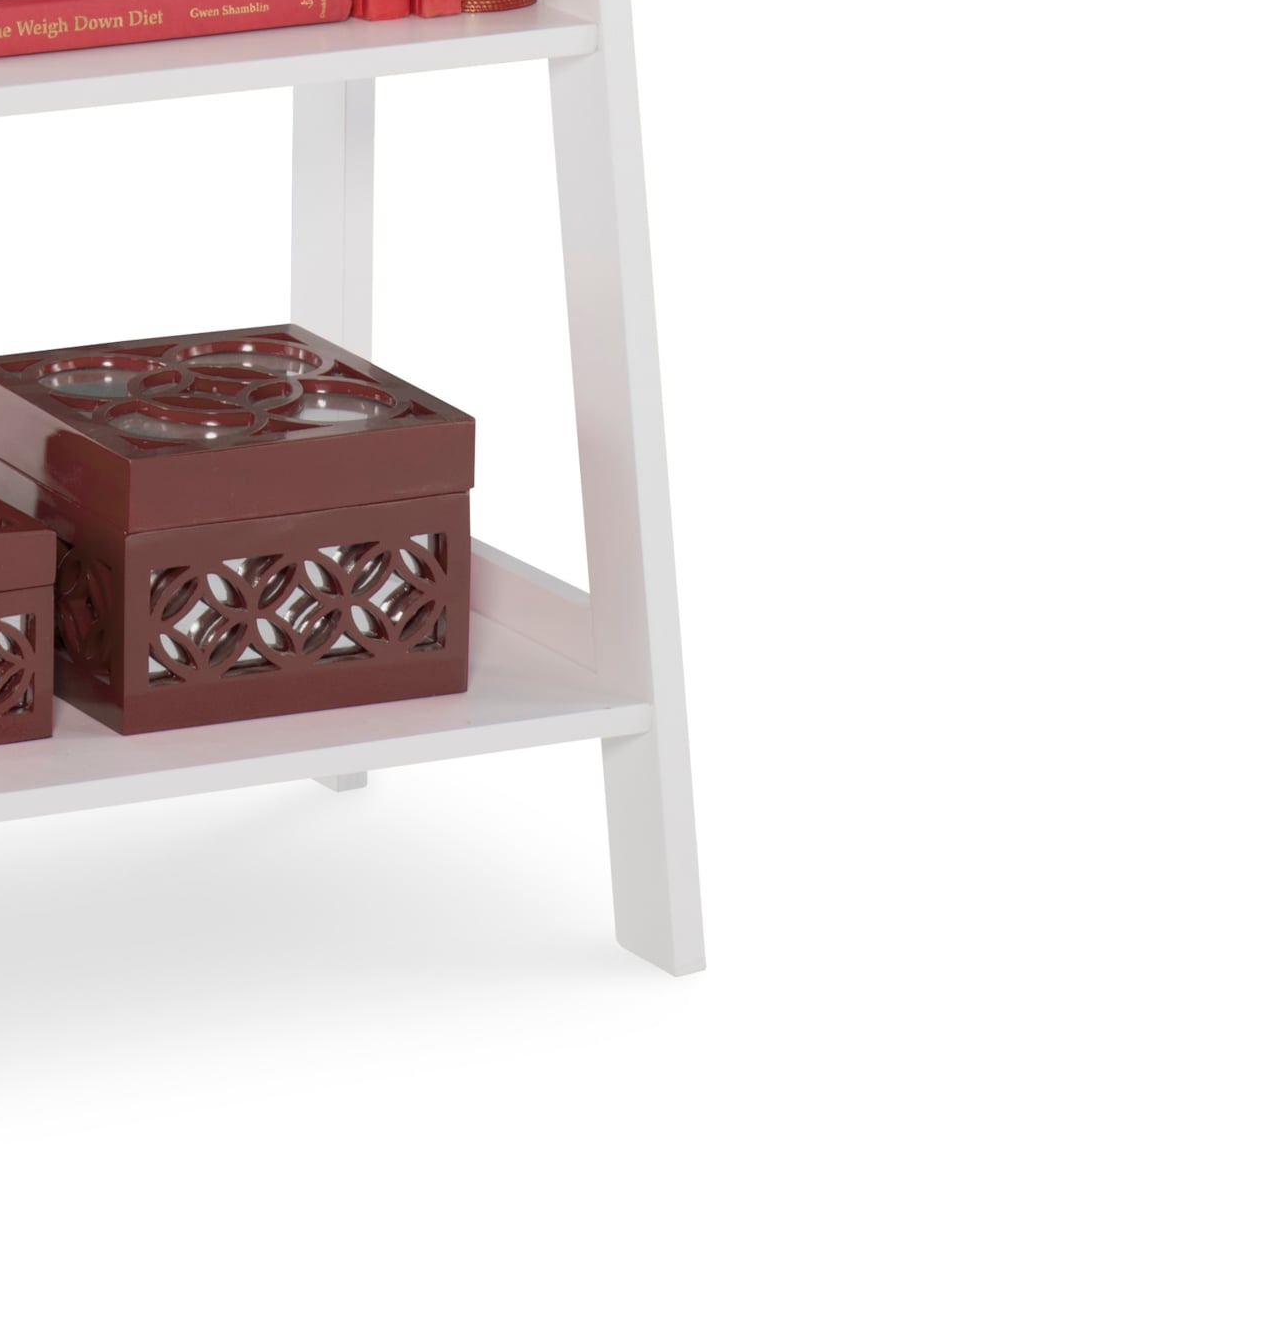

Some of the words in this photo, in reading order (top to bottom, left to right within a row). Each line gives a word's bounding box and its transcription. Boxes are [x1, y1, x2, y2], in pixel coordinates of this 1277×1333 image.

[190, 6, 220, 19] Gwen
[222, 1, 271, 16] Shamblin
[17, 18, 69, 39] Weigh
[74, 14, 124, 32] Down
[129, 9, 164, 27] Diet
